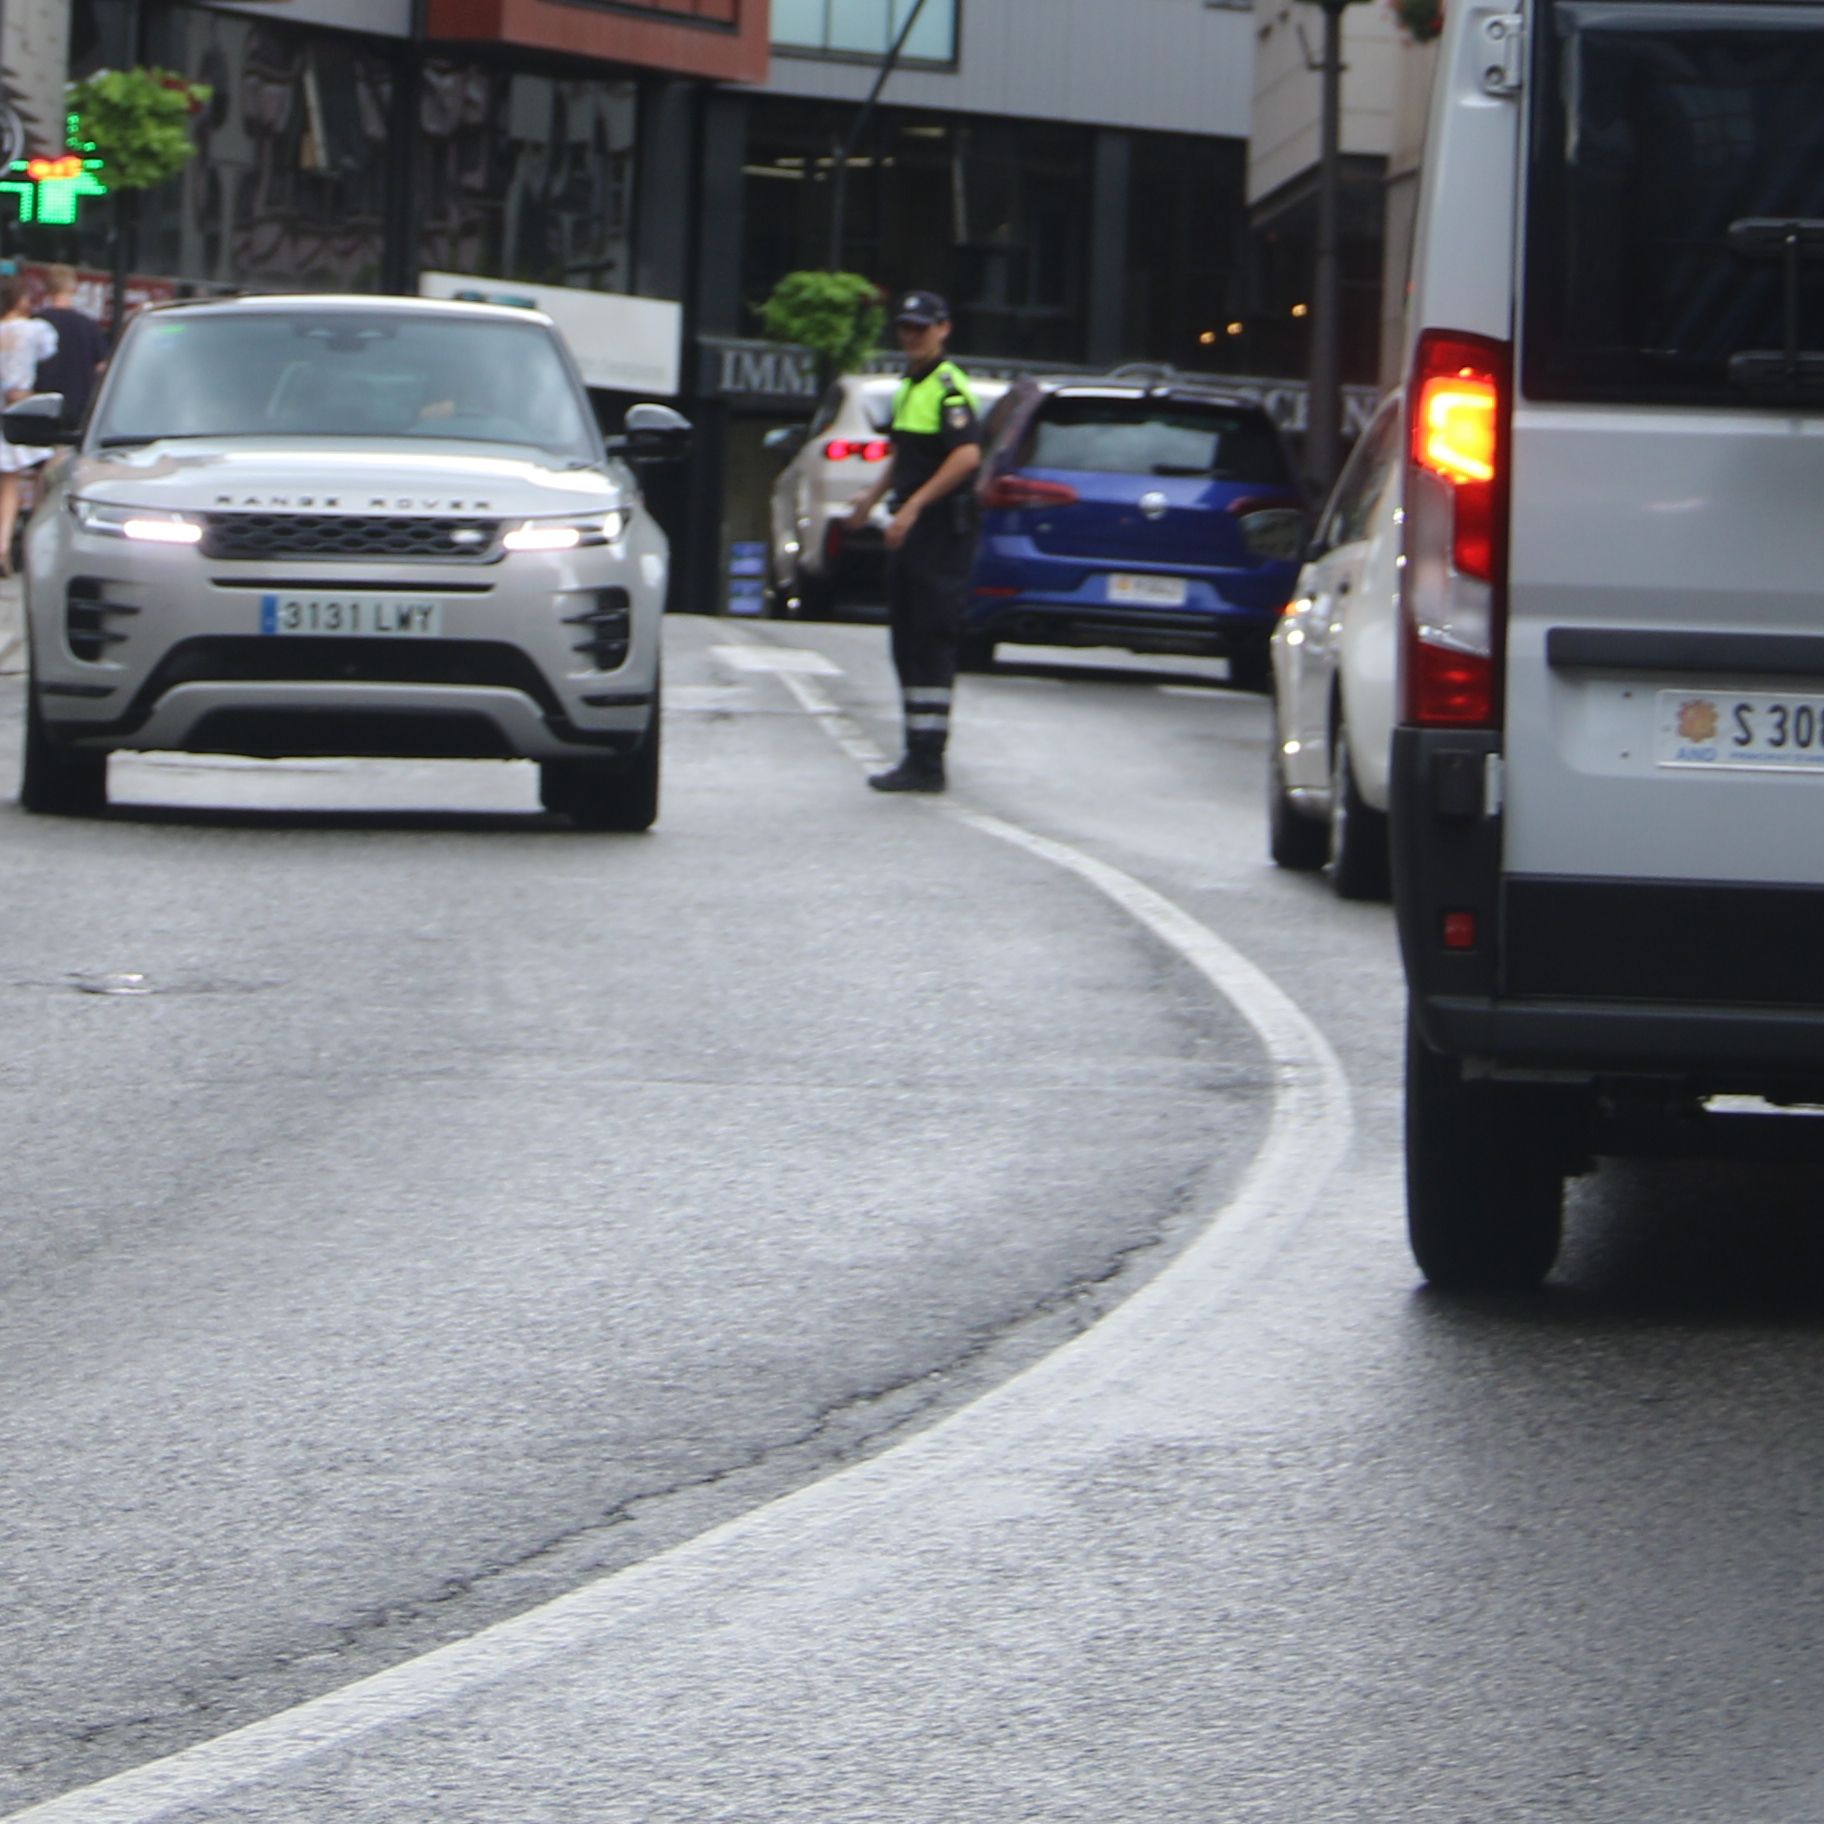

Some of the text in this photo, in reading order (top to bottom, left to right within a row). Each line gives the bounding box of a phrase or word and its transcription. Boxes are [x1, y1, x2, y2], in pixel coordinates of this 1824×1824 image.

[214, 495, 491, 511] RANGE ROVER
[283, 601, 361, 631] 3131
[1732, 702, 1754, 747] S
